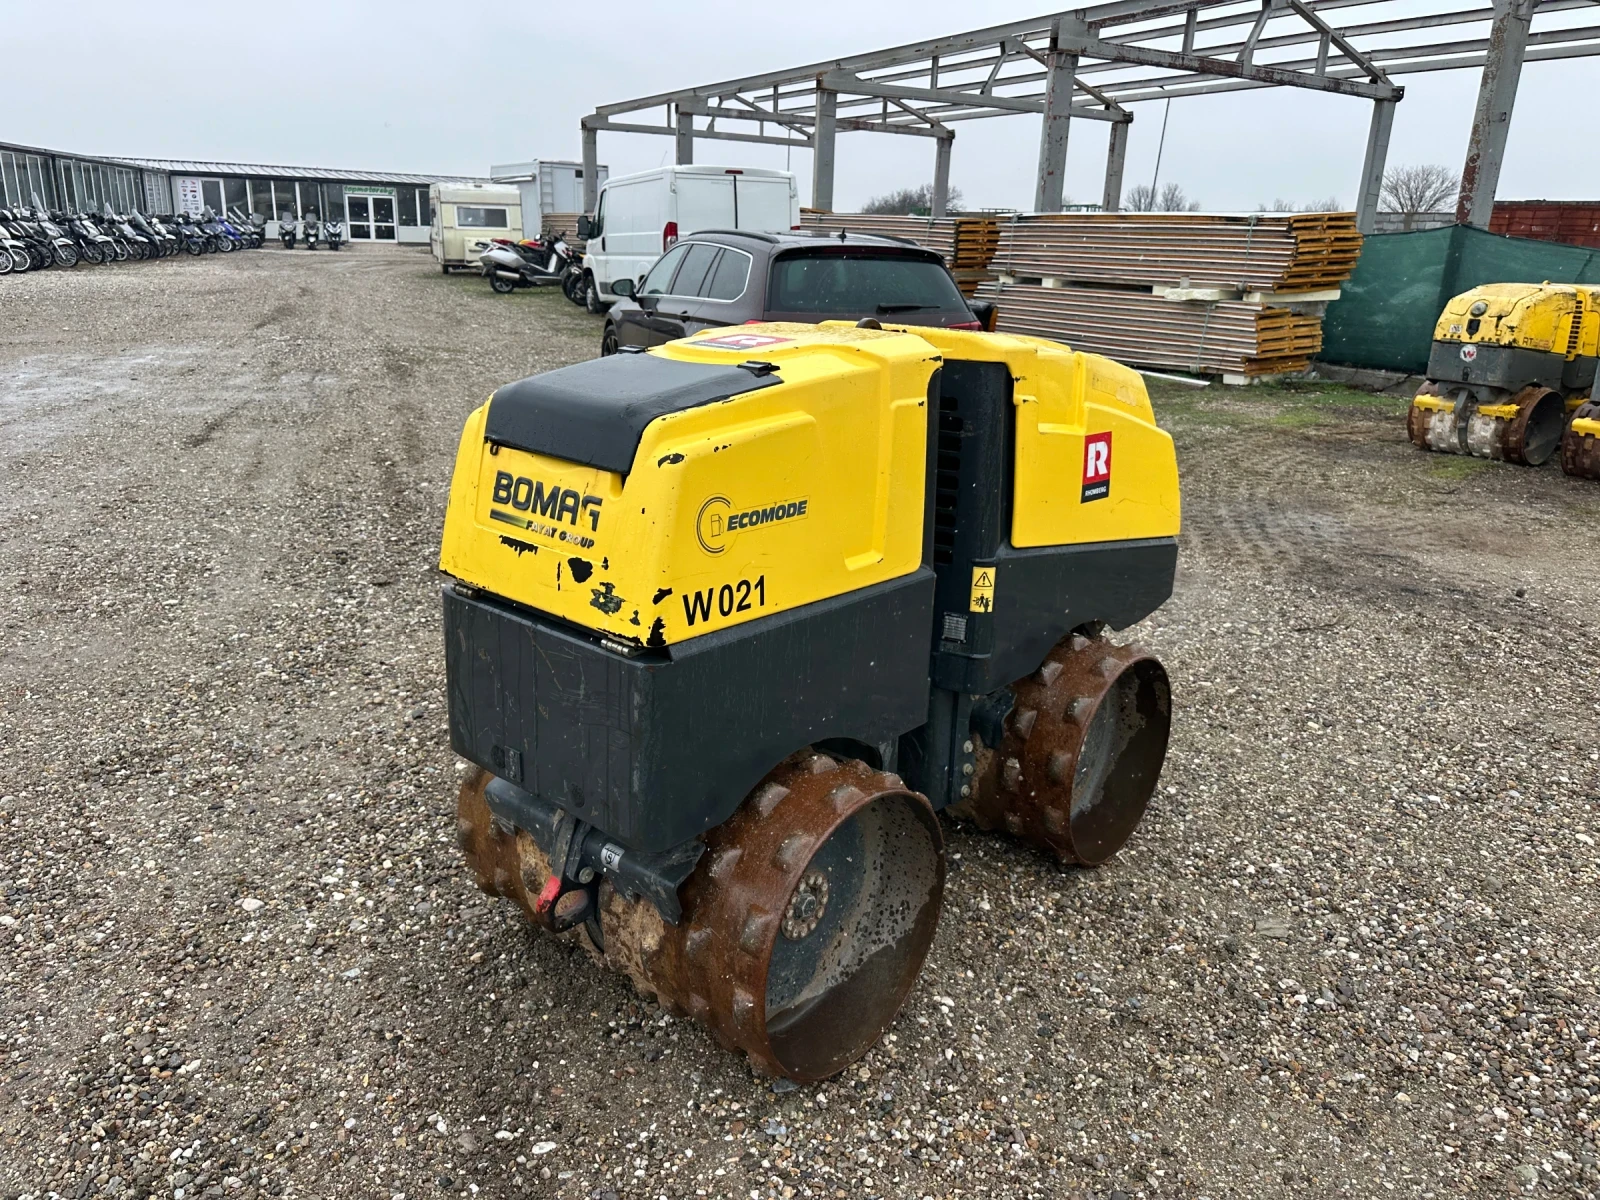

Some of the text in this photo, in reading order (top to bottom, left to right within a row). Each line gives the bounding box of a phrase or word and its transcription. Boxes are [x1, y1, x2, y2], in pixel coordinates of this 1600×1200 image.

[1086, 441, 1109, 478] R
[1084, 485, 1107, 497] RHOMBERG
[727, 500, 808, 532] ECOMODE
[526, 520, 595, 549] FAYAT GROUP
